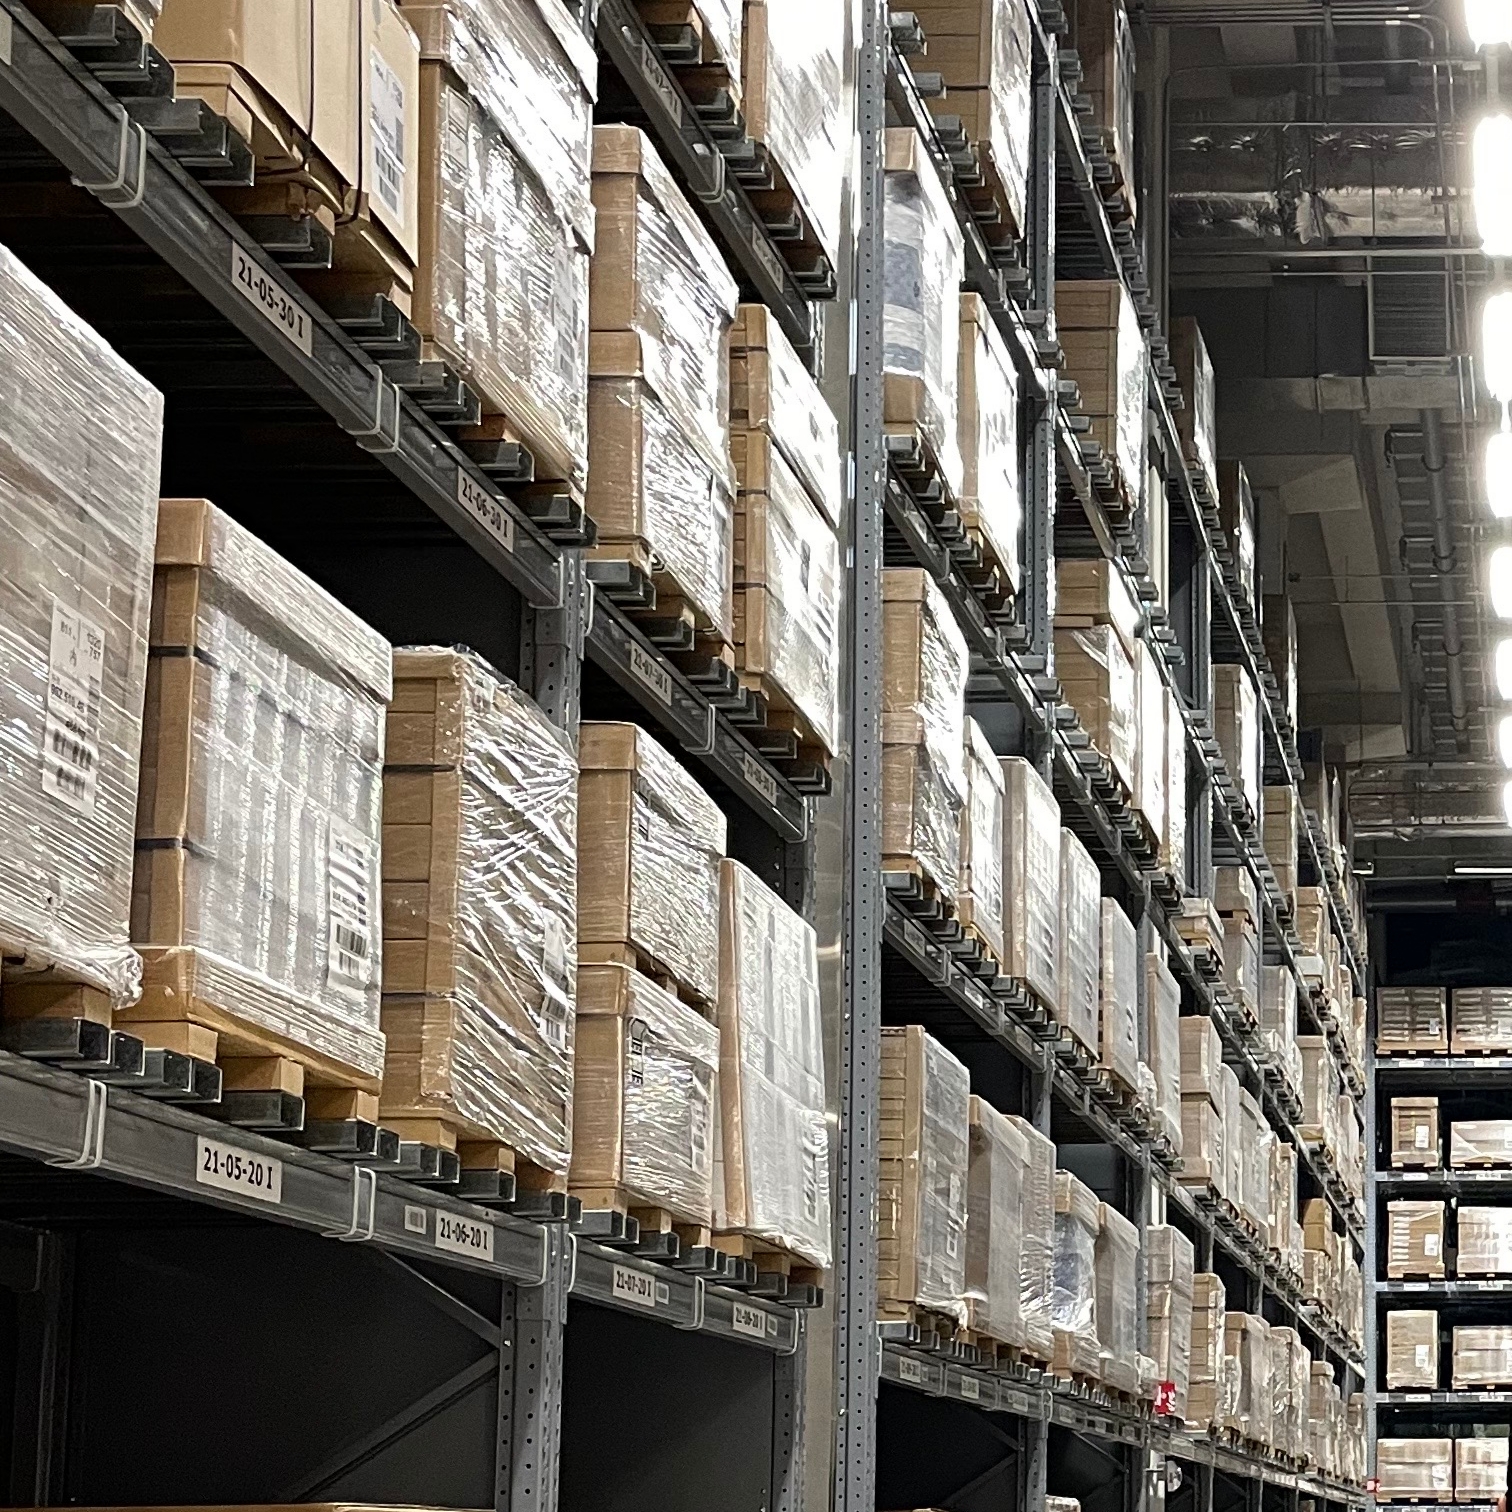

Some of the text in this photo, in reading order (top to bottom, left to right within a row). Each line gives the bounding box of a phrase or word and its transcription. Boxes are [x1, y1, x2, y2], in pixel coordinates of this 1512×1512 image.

[238, 256, 295, 329] 21-05-30
[462, 476, 502, 531] 21-06-30
[203, 1146, 264, 1187] 21-05-20
[440, 1217, 482, 1248] 21-06-20
